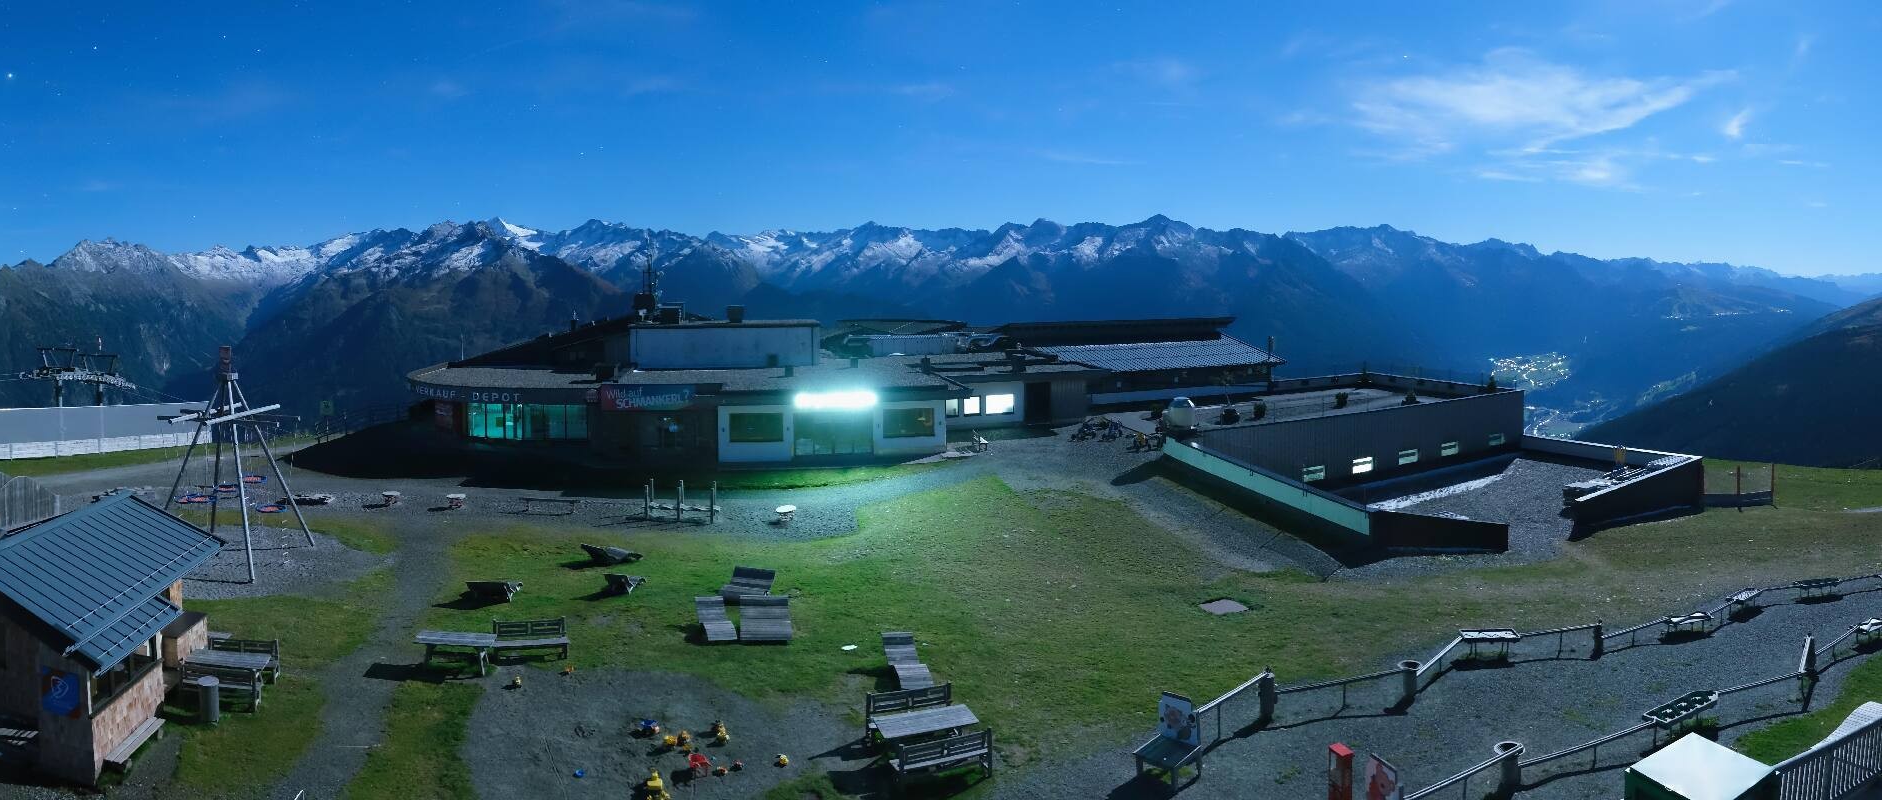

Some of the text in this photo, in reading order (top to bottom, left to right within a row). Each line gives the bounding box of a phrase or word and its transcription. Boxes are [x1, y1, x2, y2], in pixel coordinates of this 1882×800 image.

[415, 385, 456, 399] VERKAUF
[472, 392, 522, 402] DEPOT
[607, 387, 626, 399] Wild
[629, 386, 643, 398] auf
